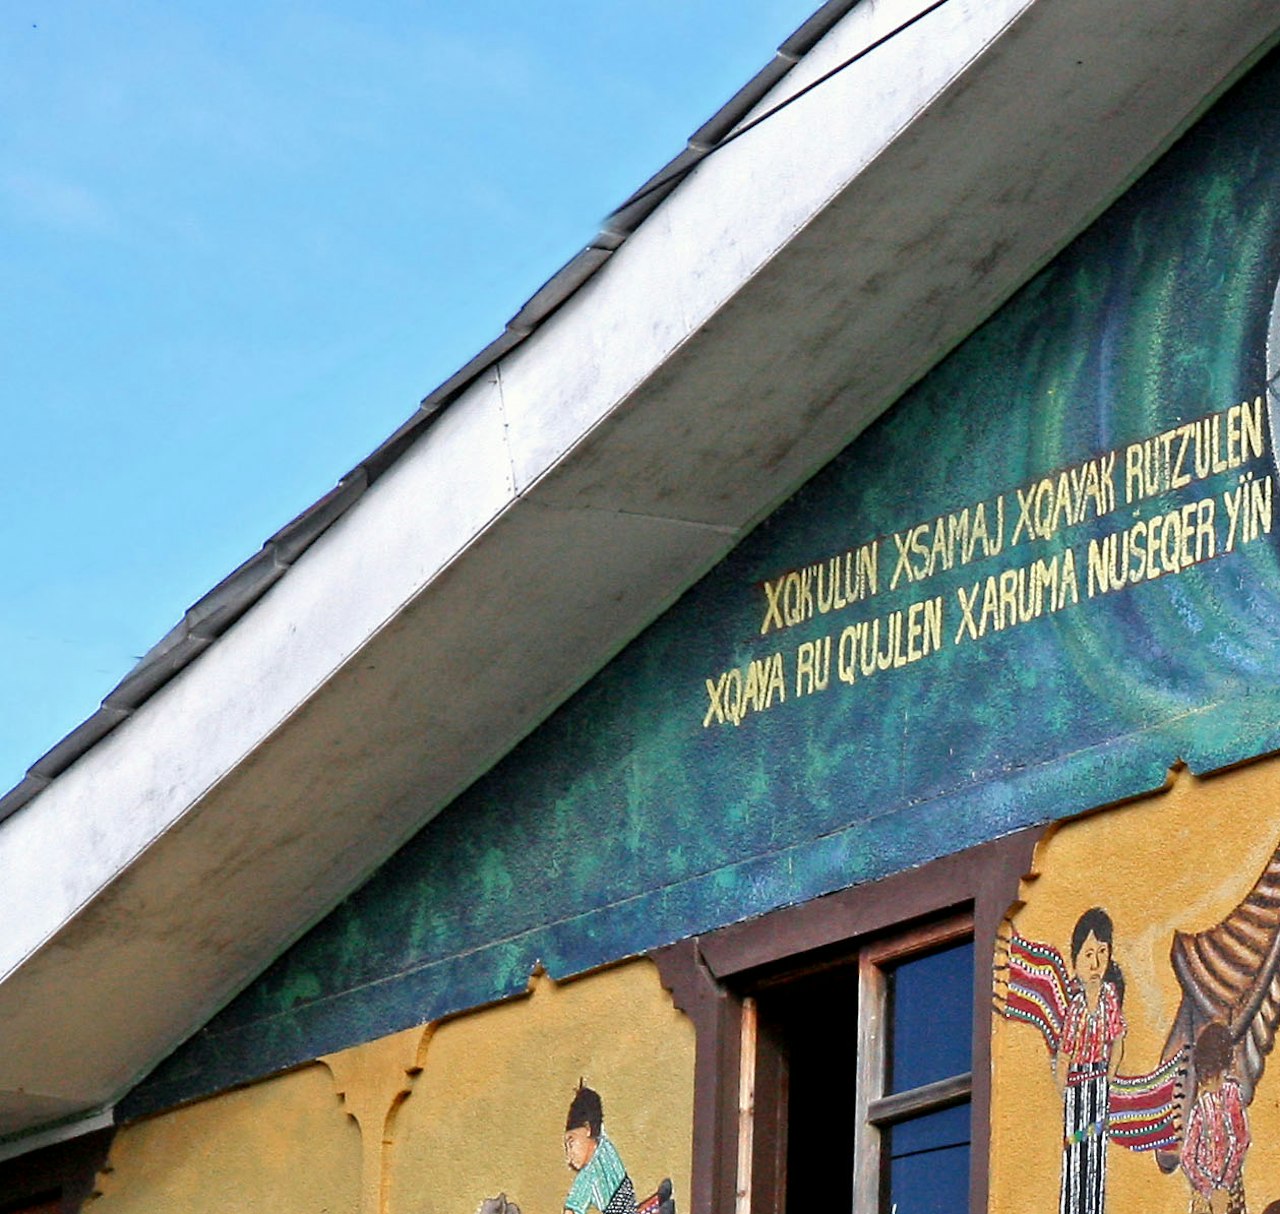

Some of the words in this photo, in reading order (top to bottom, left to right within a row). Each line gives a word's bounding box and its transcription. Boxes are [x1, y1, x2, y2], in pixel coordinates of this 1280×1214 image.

[889, 494, 1003, 591] XSAMAJ
[1011, 450, 1116, 547] XQAYAK
[796, 635, 831, 698] RU
[954, 547, 1079, 645] XARUMA
